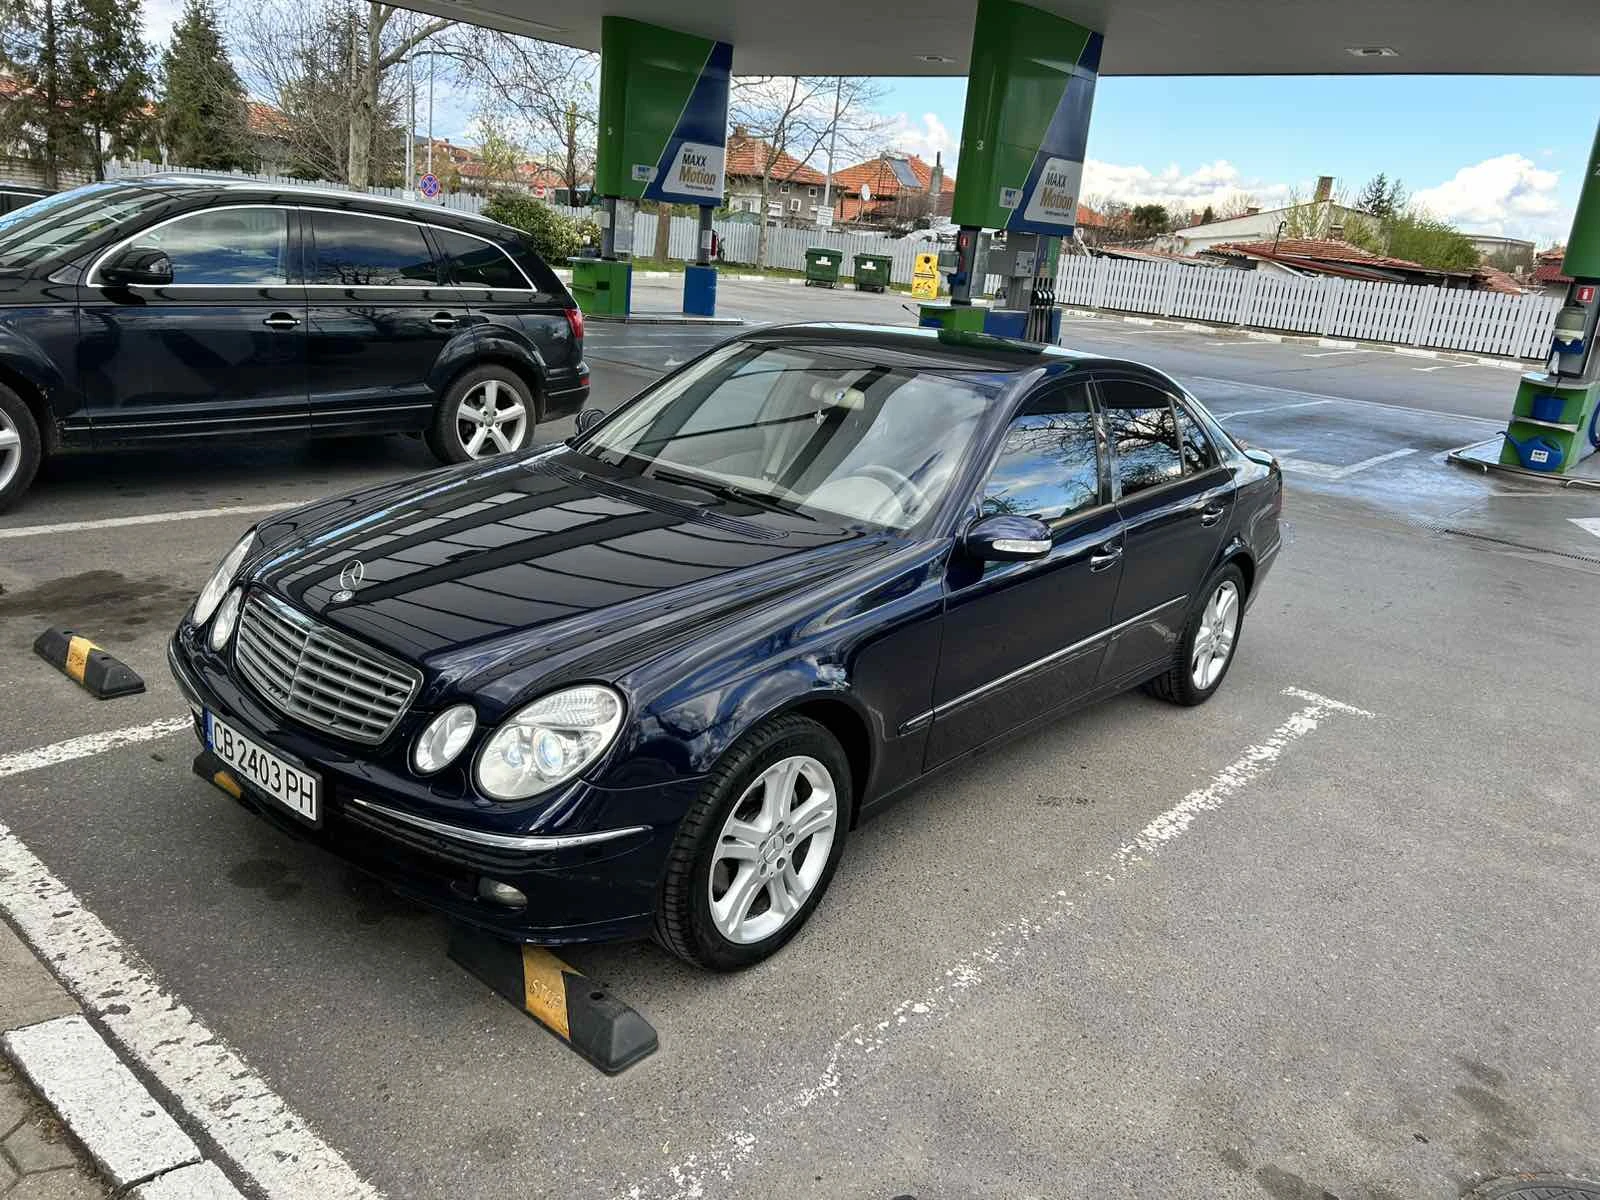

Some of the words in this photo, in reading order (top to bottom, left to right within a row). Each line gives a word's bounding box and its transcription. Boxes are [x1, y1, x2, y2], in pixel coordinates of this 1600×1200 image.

[976, 140, 984, 151] 3
[682, 153, 708, 167] MAXX
[679, 166, 717, 185] Motion
[1045, 172, 1068, 188] MAXX
[1040, 187, 1074, 210] Motion
